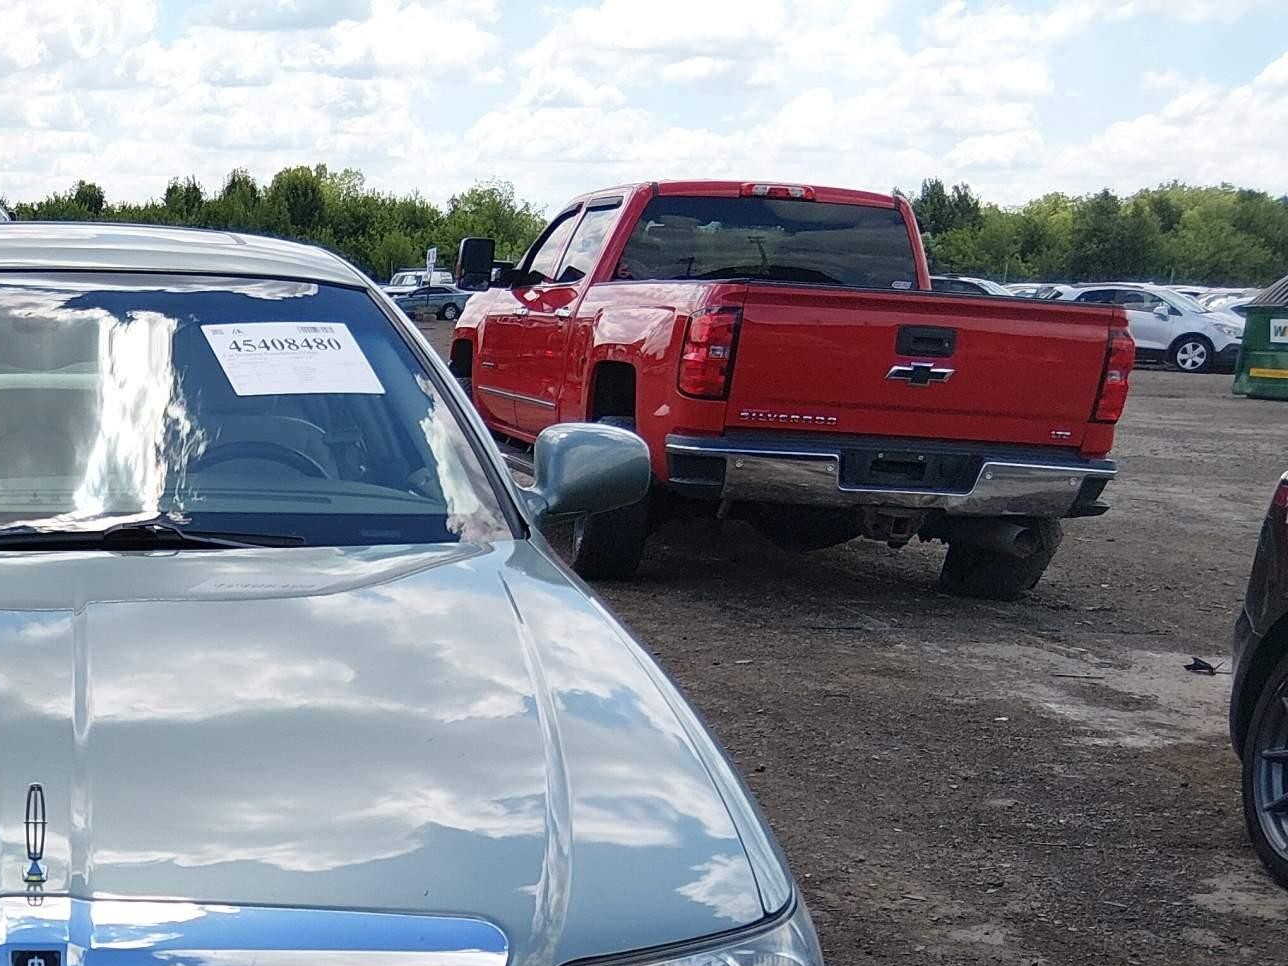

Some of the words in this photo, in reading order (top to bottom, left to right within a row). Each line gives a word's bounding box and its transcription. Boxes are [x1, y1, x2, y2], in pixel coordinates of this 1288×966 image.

[1274, 325, 1288, 337] W
[228, 337, 342, 353] 45408480
[739, 412, 837, 425] SILVERADO
